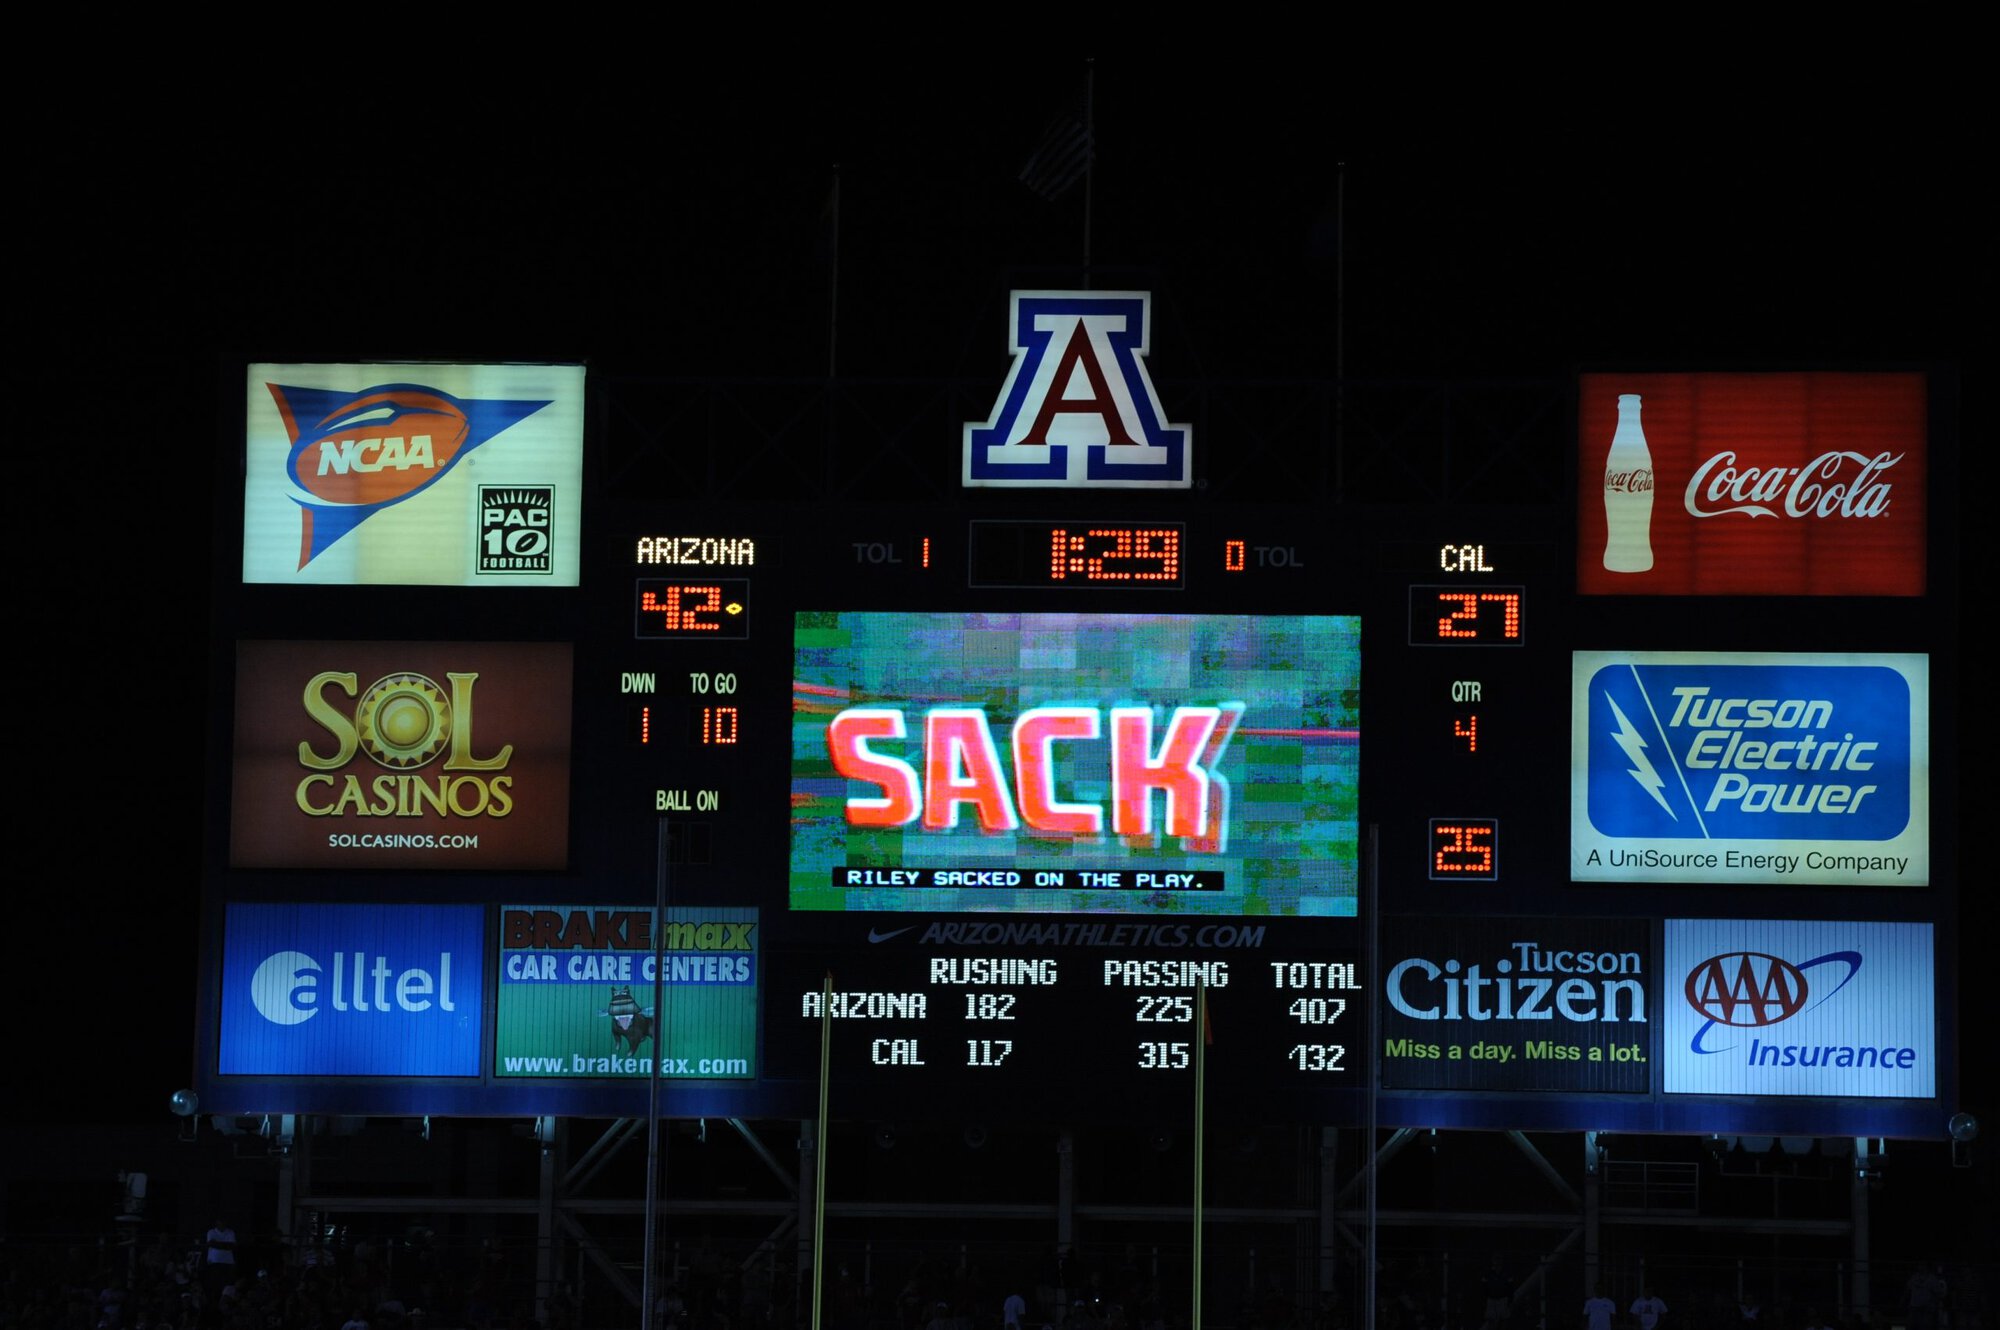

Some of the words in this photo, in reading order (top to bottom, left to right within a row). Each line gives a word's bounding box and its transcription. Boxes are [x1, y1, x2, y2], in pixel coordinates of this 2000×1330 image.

[962, 290, 1192, 488] A
[317, 434, 434, 476] NCAA
[1684, 450, 1905, 519] Coca-Cola
[483, 508, 549, 527] PAC
[482, 528, 548, 556] 10
[636, 537, 755, 565] ARIZONA
[853, 543, 902, 564] TOL
[922, 537, 930, 568] 1
[1050, 529, 1179, 580] 1:29
[1225, 540, 1244, 571] 0
[1253, 546, 1303, 568] TOL
[482, 557, 546, 568] FOOTBALL
[1439, 545, 1494, 571] CAL
[641, 586, 721, 630] 42
[1438, 593, 1519, 638] 27
[621, 672, 655, 694] DWN
[689, 673, 709, 694] TO
[714, 673, 737, 695] GO
[1451, 680, 1482, 702] QTR
[297, 671, 514, 770] SOL
[1668, 686, 1834, 729] Tucson
[642, 706, 649, 743] 1
[703, 706, 737, 744] 10
[1454, 715, 1477, 752] 4
[1685, 730, 1879, 771] Electric
[827, 700, 1246, 854] SACK
[296, 774, 513, 817] CASINOS
[656, 790, 692, 811] BALL
[696, 790, 718, 811] ON
[1703, 773, 1877, 814] Power
[328, 833, 478, 849] SOLCASINOS.COM
[1436, 826, 1492, 872] 25
[1587, 850, 1601, 867] A
[1609, 850, 1718, 869] UniSource
[1725, 851, 1799, 874] Energy
[1806, 852, 1908, 875] Company
[847, 870, 919, 886] RILEY
[934, 871, 1020, 887] SACKED
[1034, 872, 1064, 887] ON
[1079, 873, 1121, 888] THE
[1136, 873, 1204, 889] PLAY.
[504, 910, 652, 950] BRAKE
[654, 921, 757, 951] max
[919, 922, 1267, 949] ARIZONAATHLETICS.COM
[506, 954, 558, 981] CAR
[567, 954, 632, 981] CARE
[641, 956, 751, 983] CENTERS
[1512, 942, 1642, 973] Tucson
[930, 958, 1058, 985] RUSHING
[1103, 960, 1229, 988] PASSING
[1271, 962, 1362, 989] TOTAL
[1386, 957, 1647, 1023] Citizen
[1700, 956, 1796, 1025] AAA
[802, 991, 927, 1019] ARIZONA
[964, 993, 1017, 1020] 182
[1135, 995, 1193, 1023] 225
[1289, 998, 1346, 1025] 407
[504, 1054, 748, 1075] www.brakemax.com
[872, 1039, 925, 1065] CAL
[966, 1039, 1013, 1067] 117
[1137, 1042, 1190, 1069] 315
[1385, 1039, 1441, 1059] Miss
[1447, 1044, 1462, 1059] a
[1468, 1040, 1517, 1063] day.
[1526, 1041, 1581, 1061] Miss
[1588, 1046, 1602, 1061] a
[1609, 1042, 1646, 1063] lot.
[1748, 1038, 1917, 1069] Insurance
